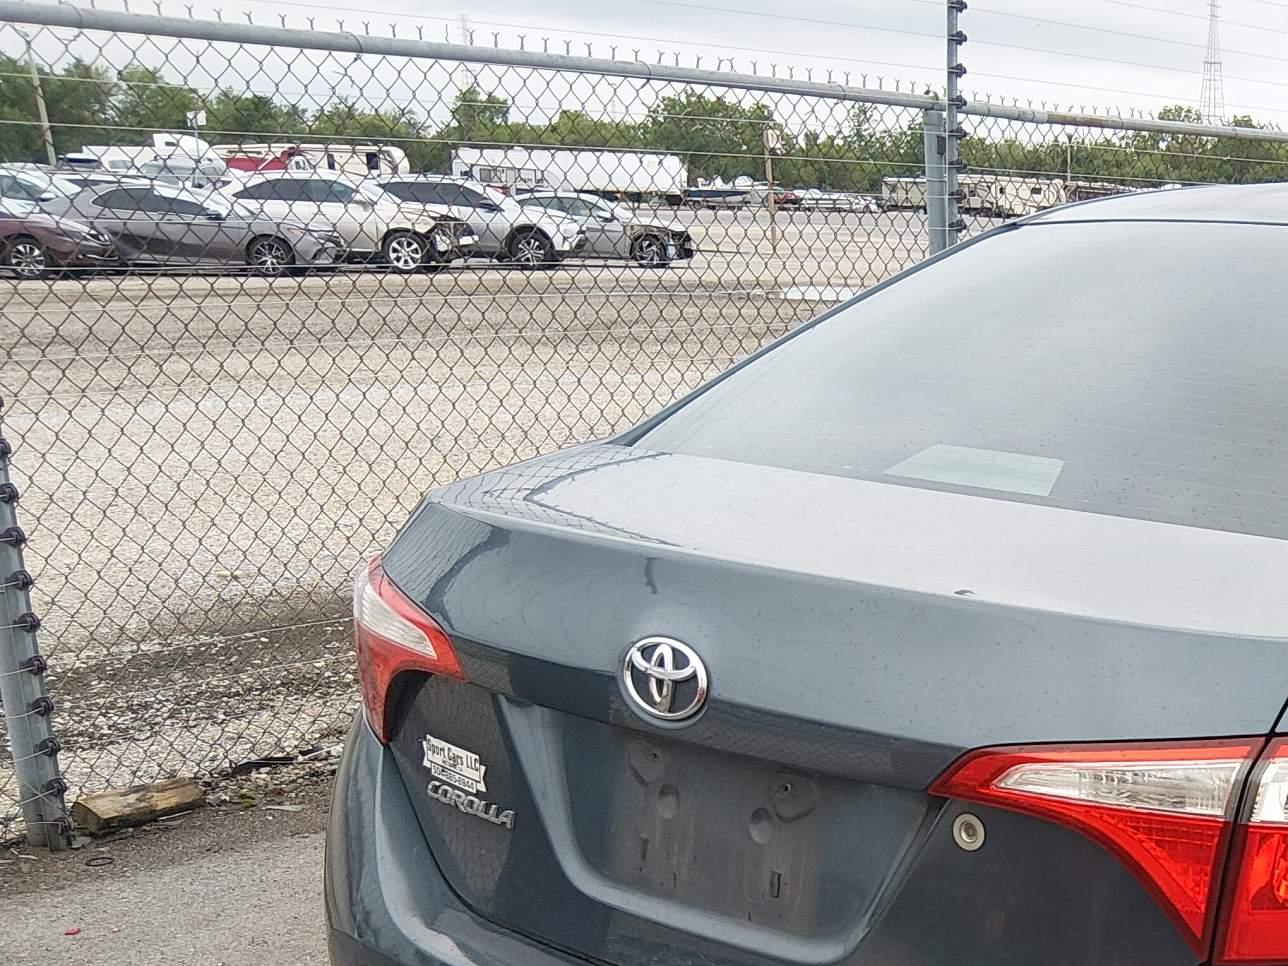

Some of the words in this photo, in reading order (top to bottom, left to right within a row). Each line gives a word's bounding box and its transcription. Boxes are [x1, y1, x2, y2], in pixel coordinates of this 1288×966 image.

[427, 738, 446, 759] Sport
[447, 747, 464, 766] Cars
[466, 754, 479, 772] LLC
[427, 781, 515, 829] COROLLA
